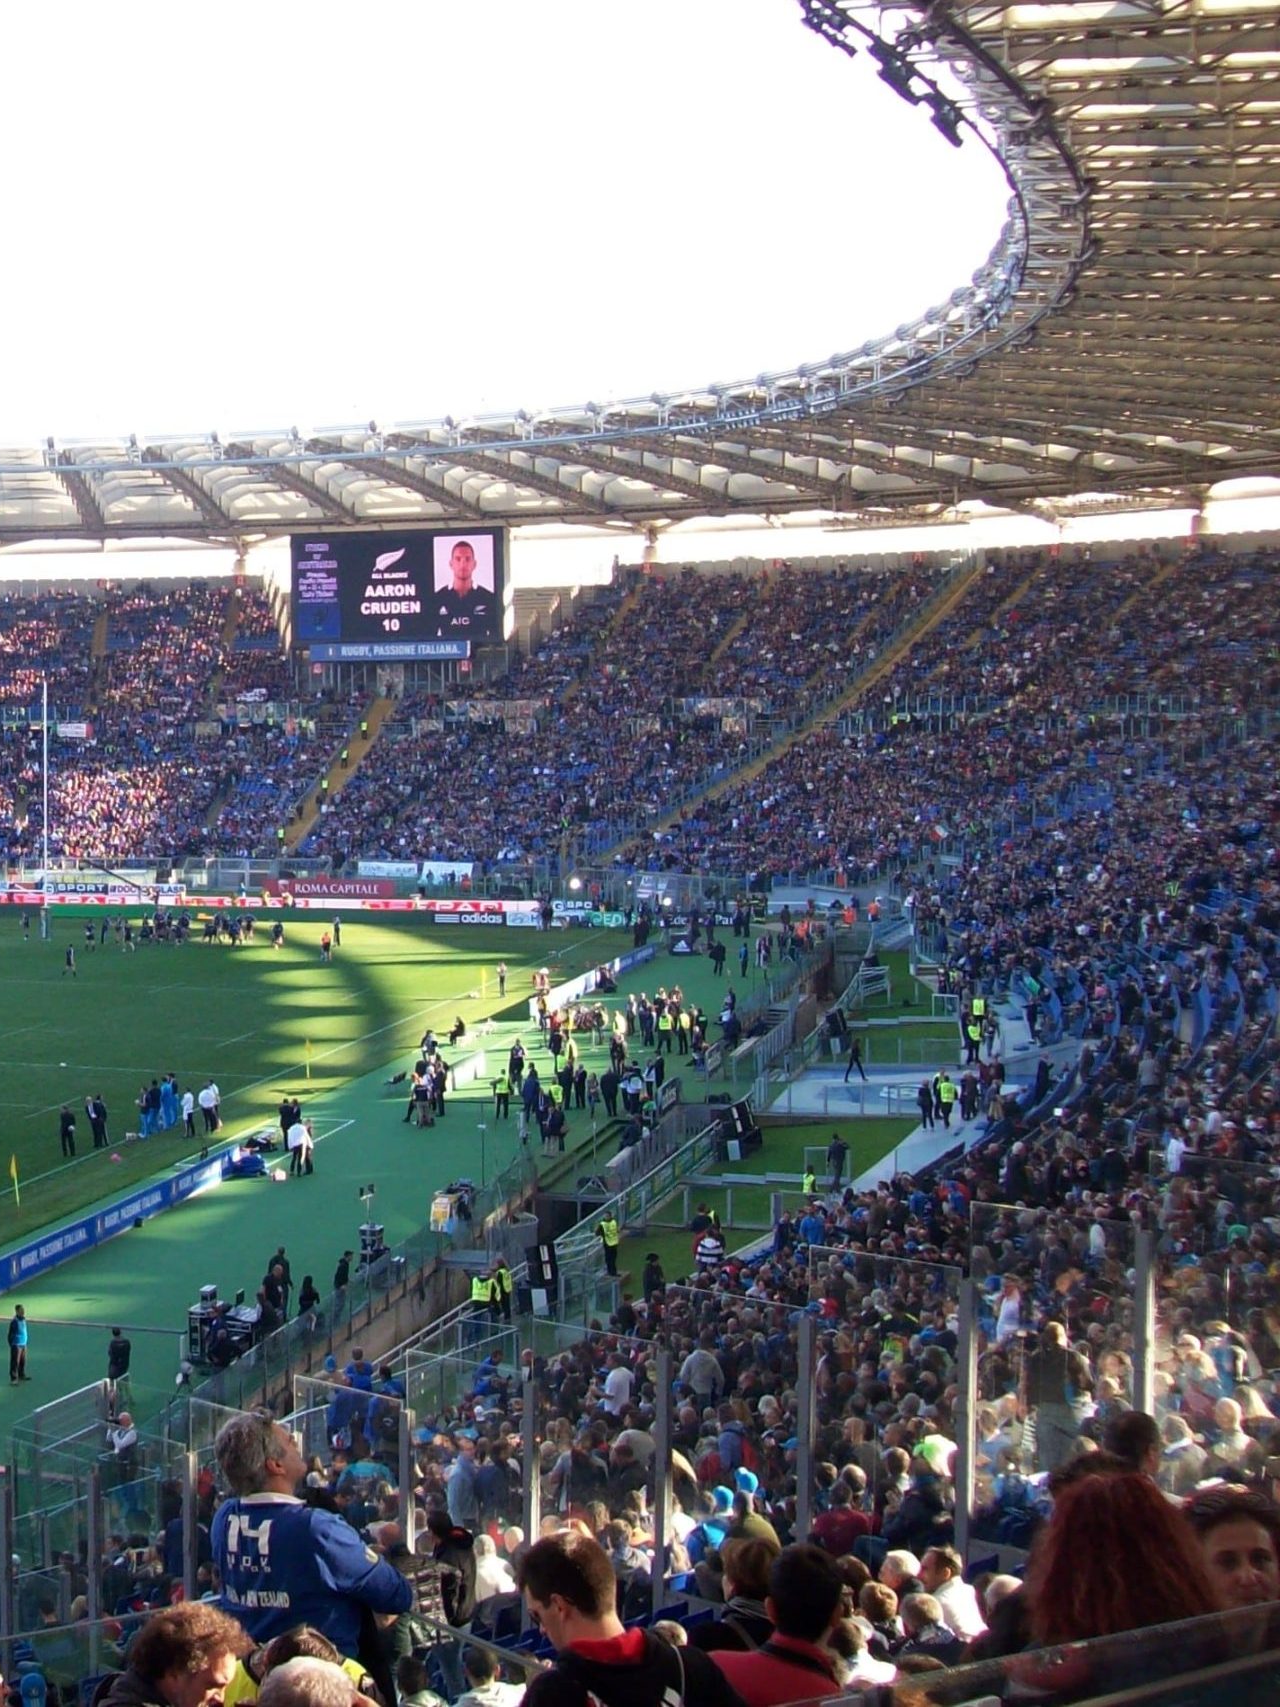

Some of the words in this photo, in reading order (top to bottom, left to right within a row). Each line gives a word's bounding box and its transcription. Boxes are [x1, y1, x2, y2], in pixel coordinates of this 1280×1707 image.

[364, 584, 416, 598] AARON
[360, 601, 421, 615] CRUDEN
[382, 618, 401, 632] 10
[57, 883, 105, 892] SPORT
[294, 884, 329, 893] ROMA
[330, 884, 380, 895] CAPITALE
[461, 912, 502, 923] adidas
[227, 1514, 273, 1555] 14
